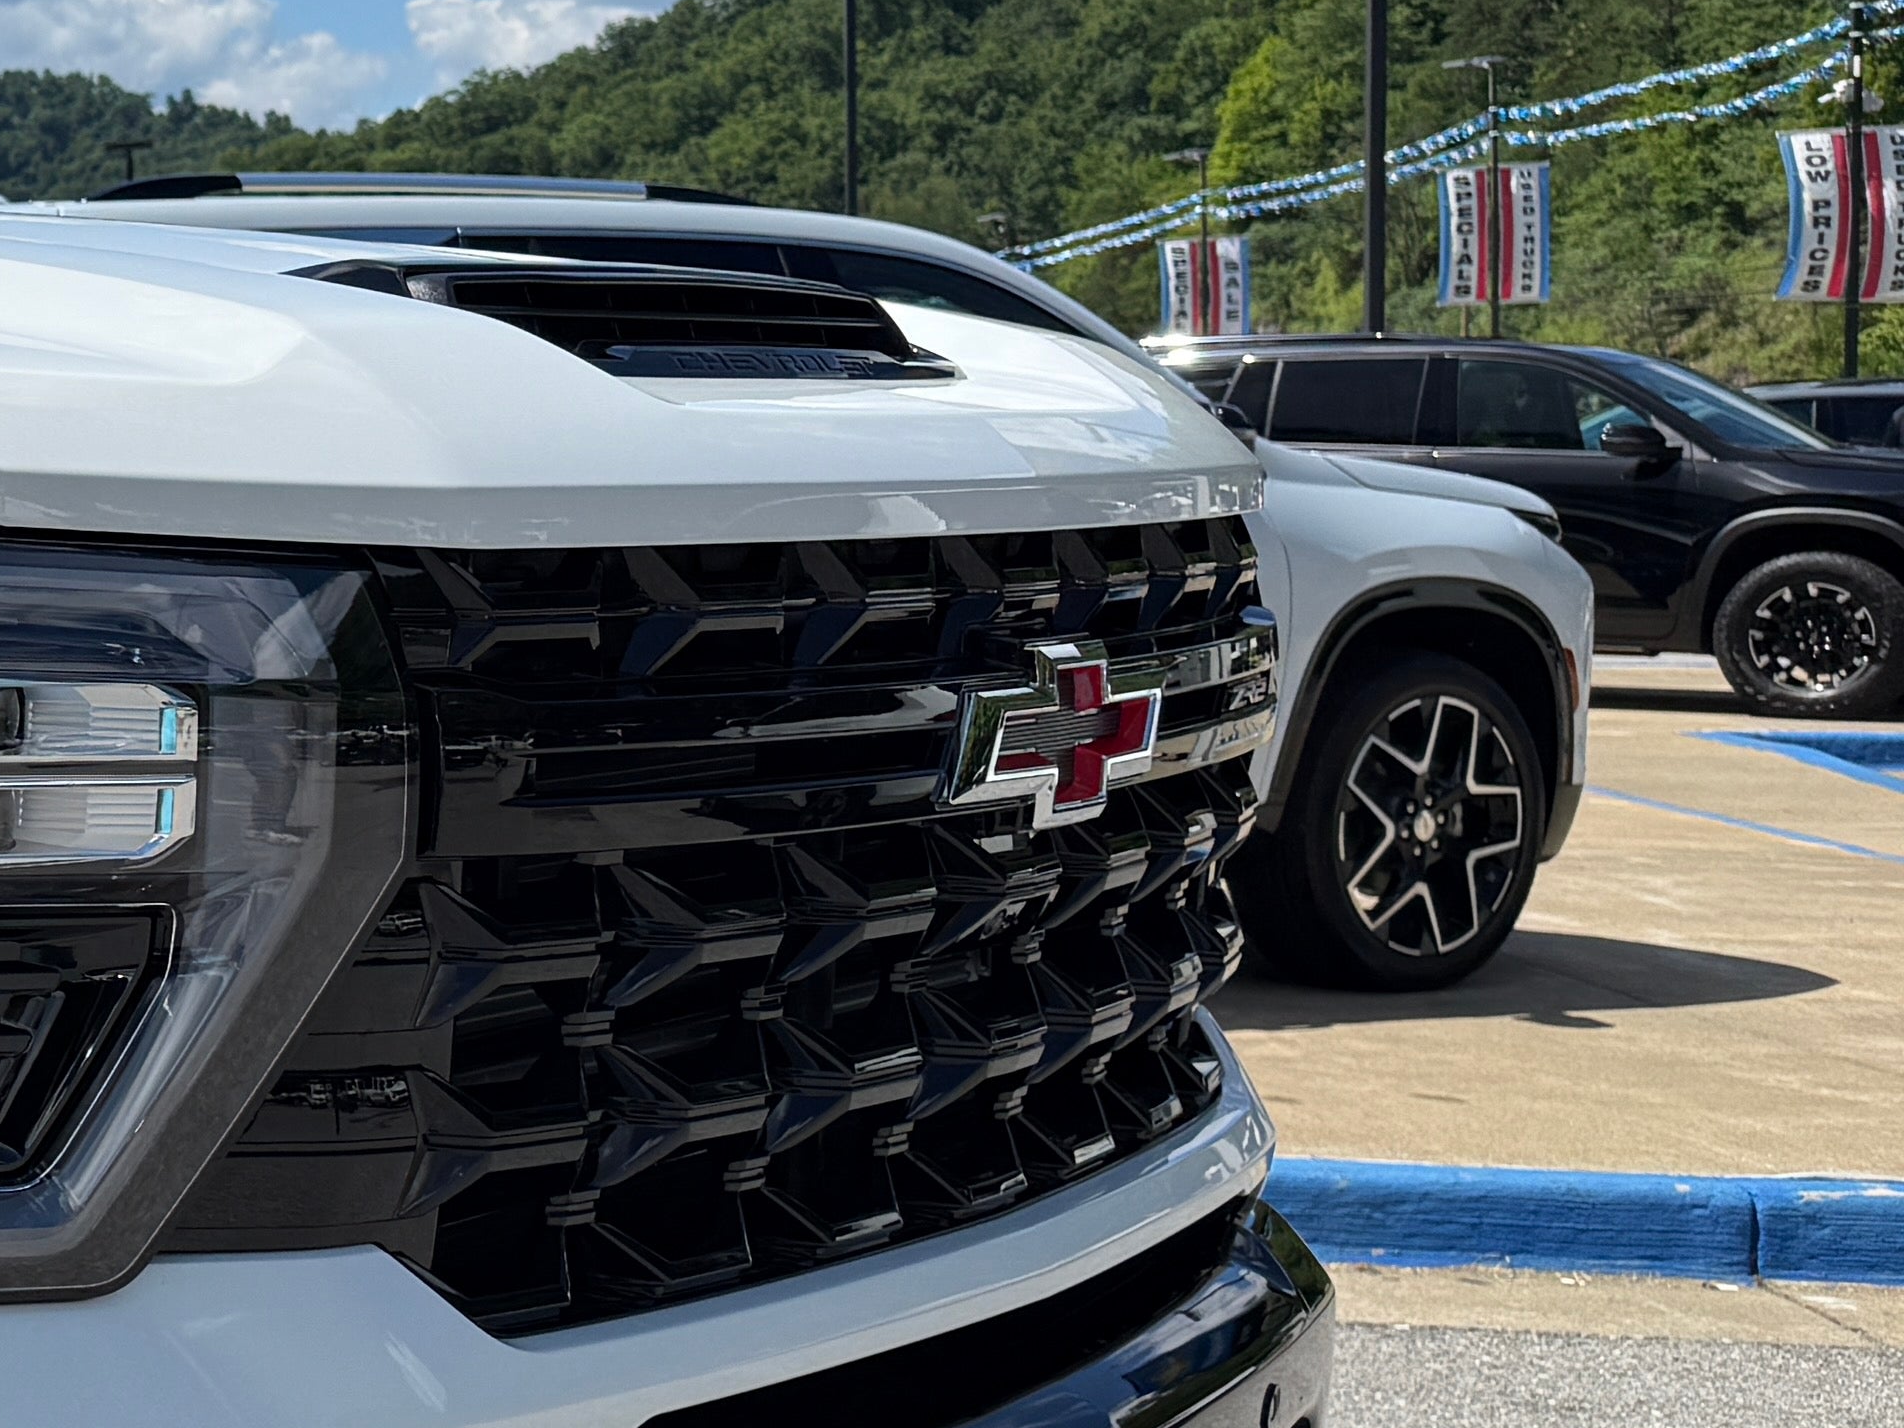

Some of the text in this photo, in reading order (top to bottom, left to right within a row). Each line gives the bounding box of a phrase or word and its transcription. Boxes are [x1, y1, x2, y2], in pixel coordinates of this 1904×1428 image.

[1453, 174, 1474, 298] SPECIALS
[1800, 140, 1832, 293] LOW PRICES
[667, 351, 874, 376] CHEVROLET
